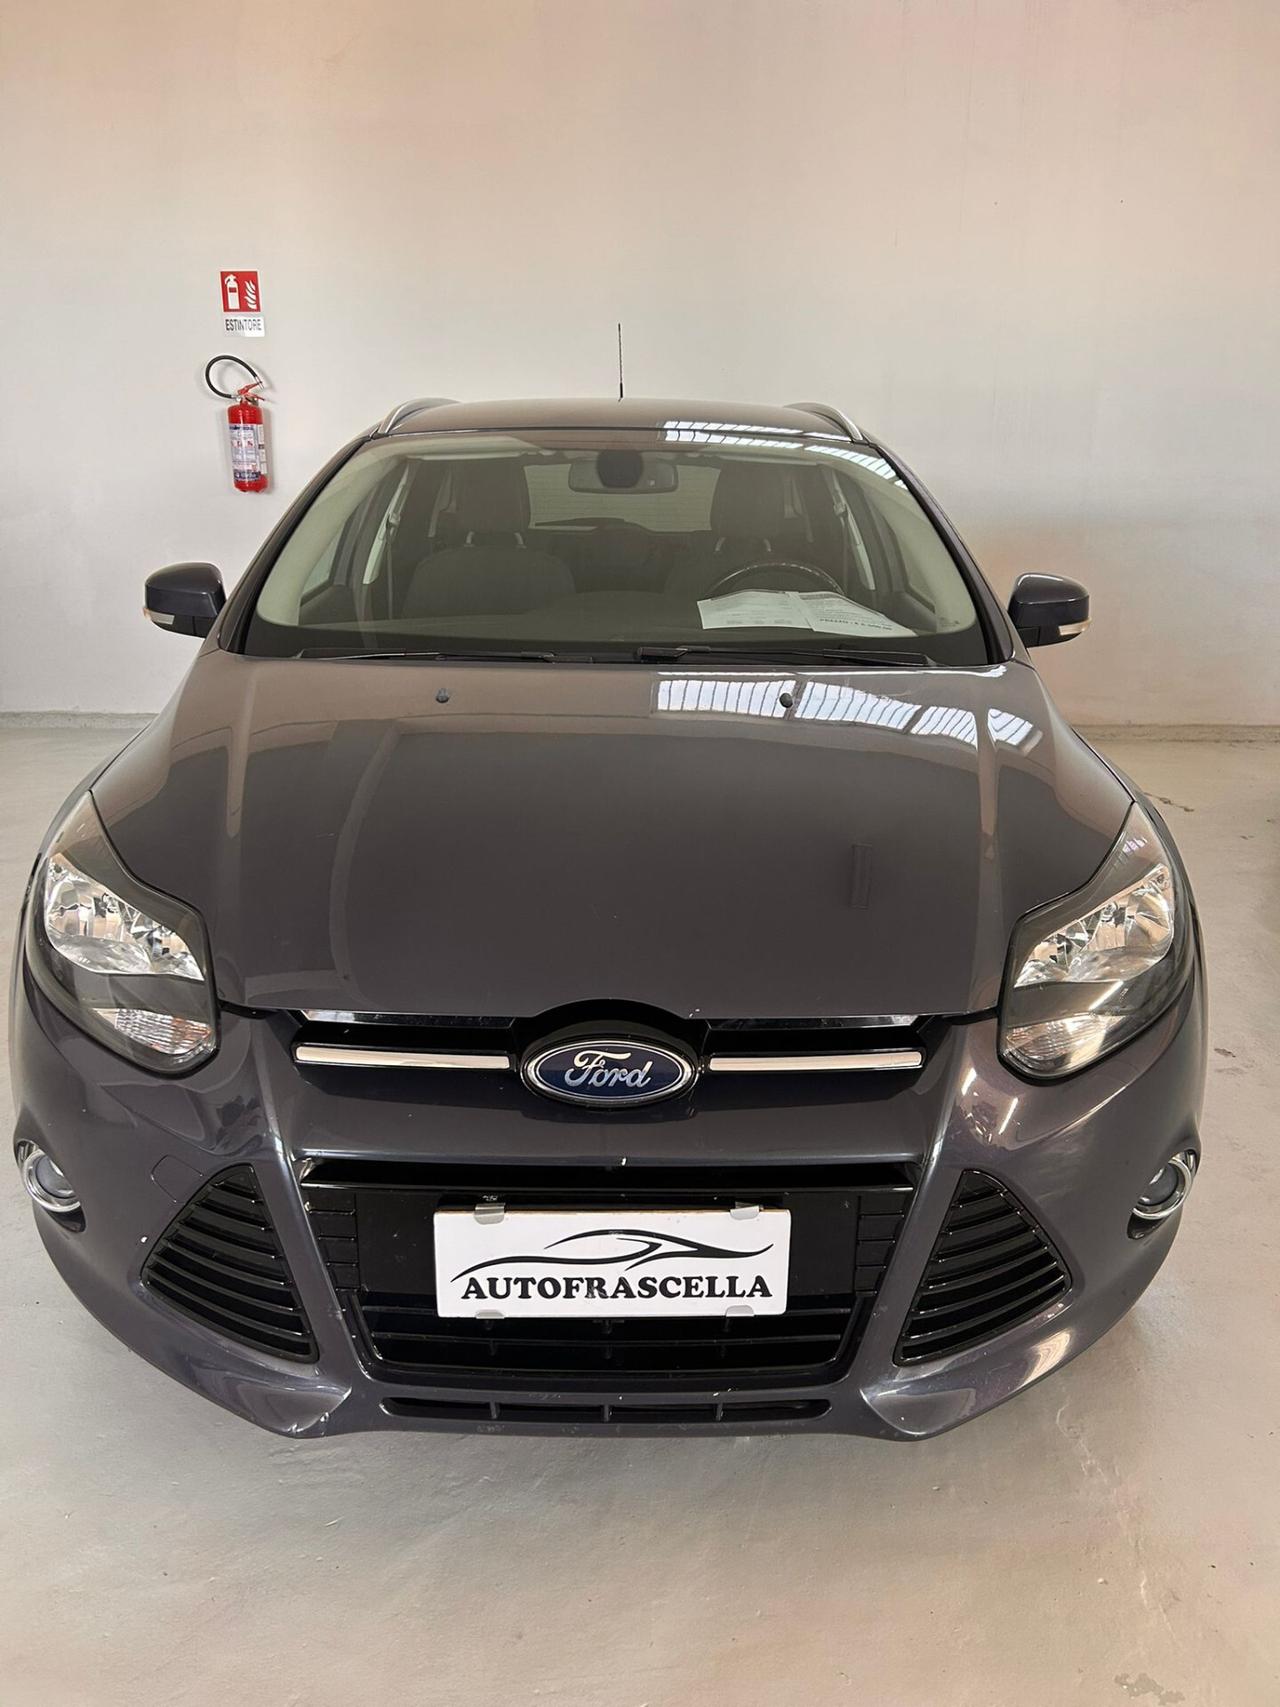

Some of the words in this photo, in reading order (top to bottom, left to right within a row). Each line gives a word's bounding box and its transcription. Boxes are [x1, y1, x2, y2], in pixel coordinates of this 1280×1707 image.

[225, 318, 262, 331] ESTINTORE
[564, 1050, 653, 1088] Ford
[460, 1275, 773, 1300] AUTOFRASCELLA
